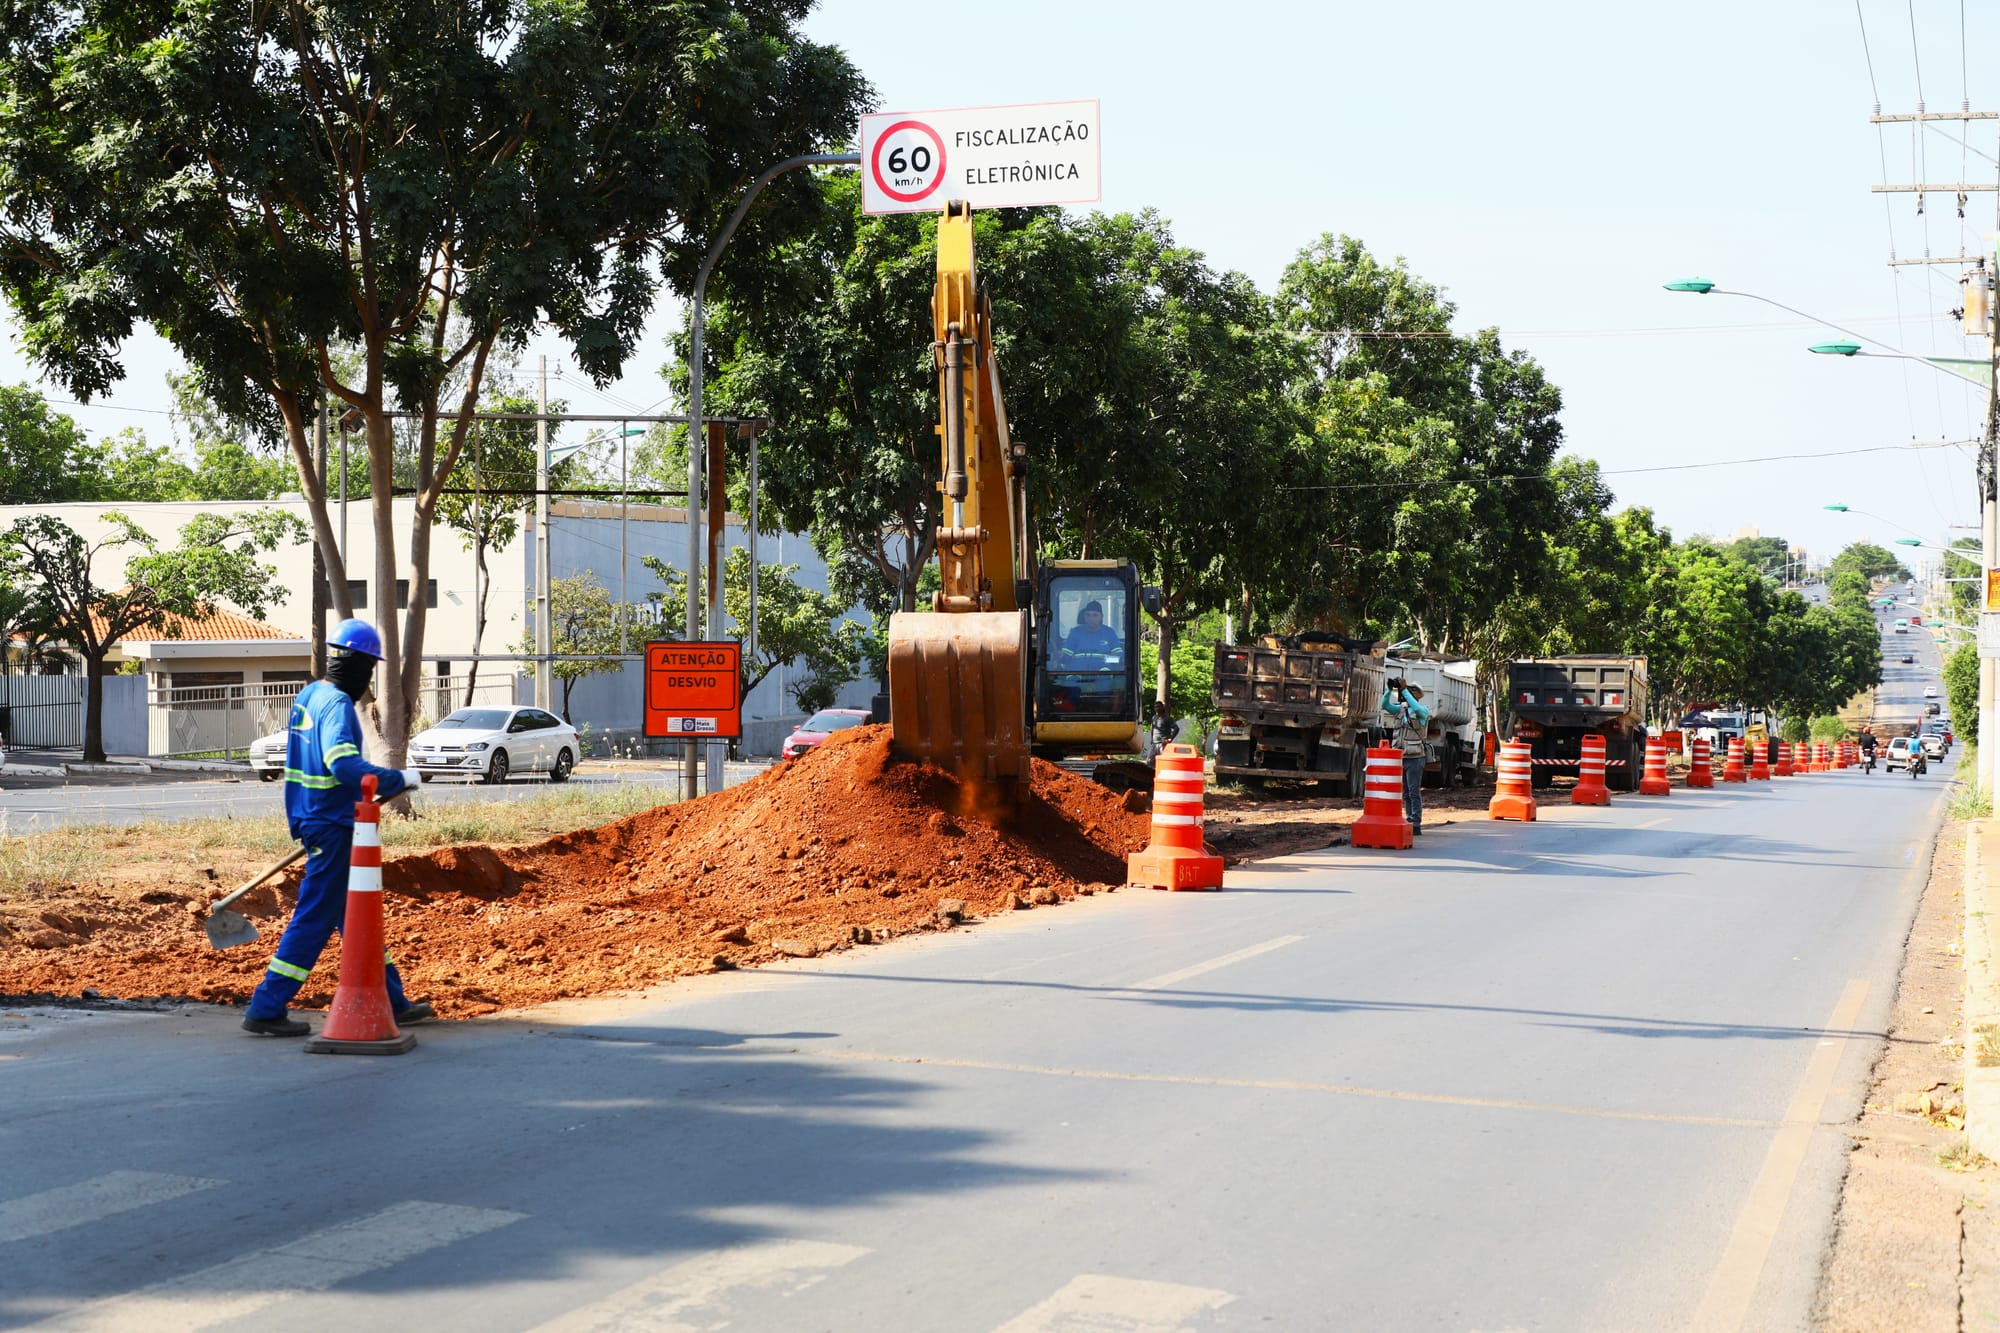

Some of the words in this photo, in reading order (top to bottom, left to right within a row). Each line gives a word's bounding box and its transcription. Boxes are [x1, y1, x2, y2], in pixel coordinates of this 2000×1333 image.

[956, 120, 1089, 148] FISCALIZAÇÃO
[888, 146, 931, 173] 60
[895, 177, 923, 187] km/h
[966, 161, 1079, 184] ELETRÔNICA
[661, 651, 726, 668] ATENÇÃO
[668, 677, 717, 688] DESVIO
